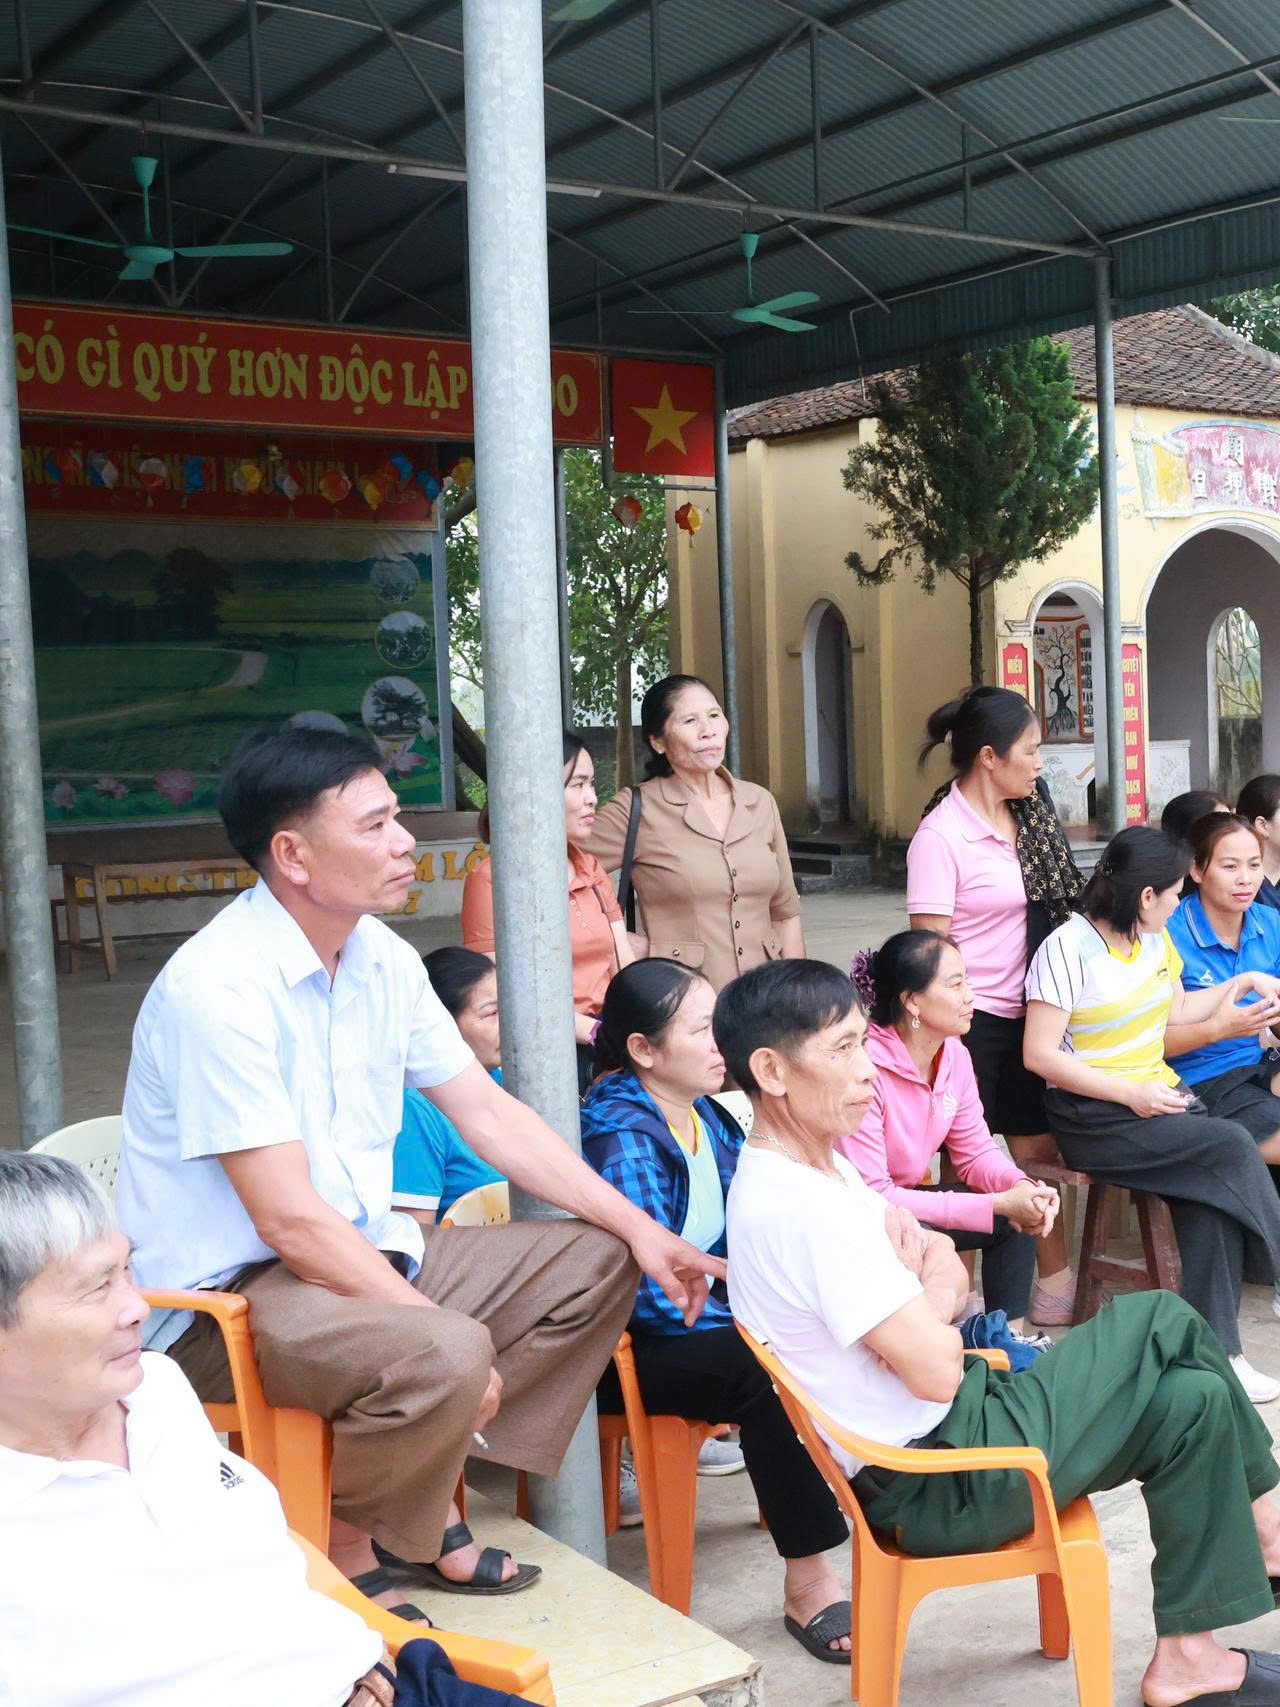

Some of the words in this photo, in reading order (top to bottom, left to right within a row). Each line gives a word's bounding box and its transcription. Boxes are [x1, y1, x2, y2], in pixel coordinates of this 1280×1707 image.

[15, 319, 65, 385] CÓ
[77, 324, 123, 389] GÌ
[133, 332, 217, 401] QUÝ
[227, 347, 308, 400] HƠN
[319, 343, 393, 414] ĐỘC
[401, 350, 468, 420] LẬP
[551, 373, 578, 417] O
